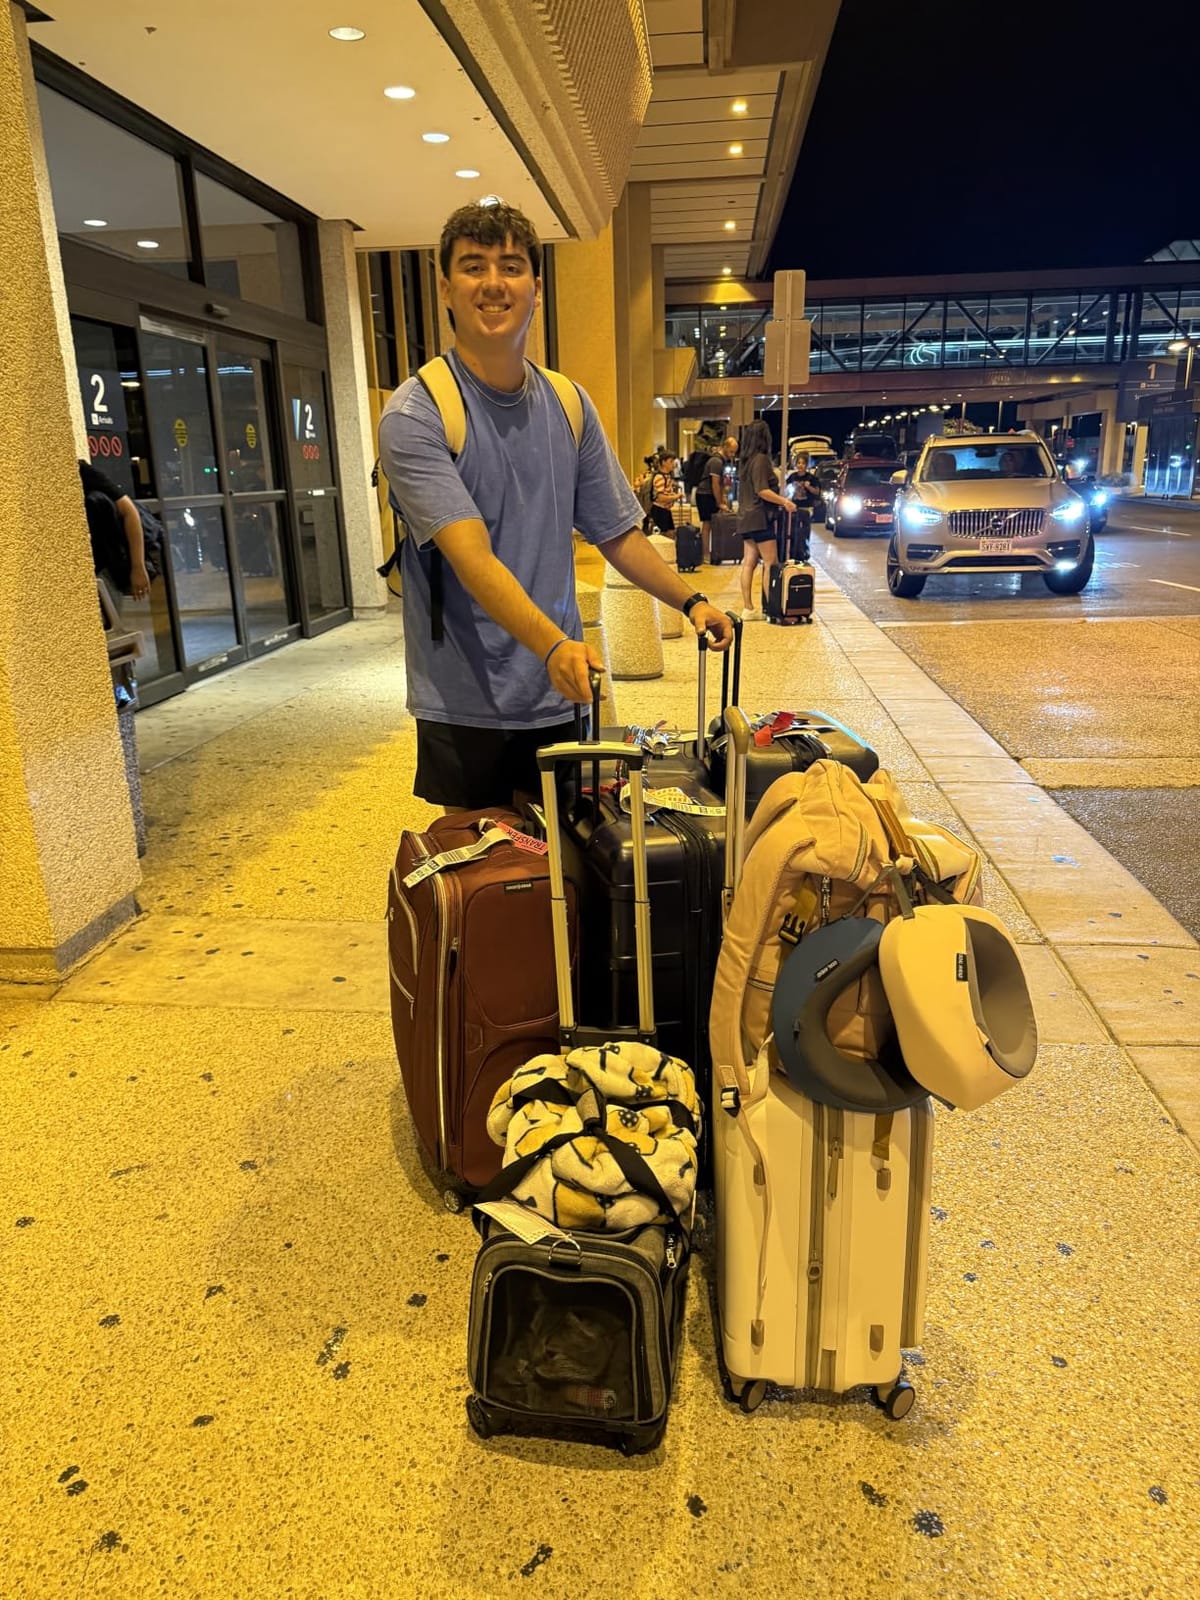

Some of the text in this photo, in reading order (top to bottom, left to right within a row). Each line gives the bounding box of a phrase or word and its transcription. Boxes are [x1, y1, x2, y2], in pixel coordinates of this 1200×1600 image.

[1147, 363, 1157, 380] 1
[90, 373, 108, 412] 2
[304, 404, 314, 430] 2
[505, 829, 547, 850] TRANSFER
